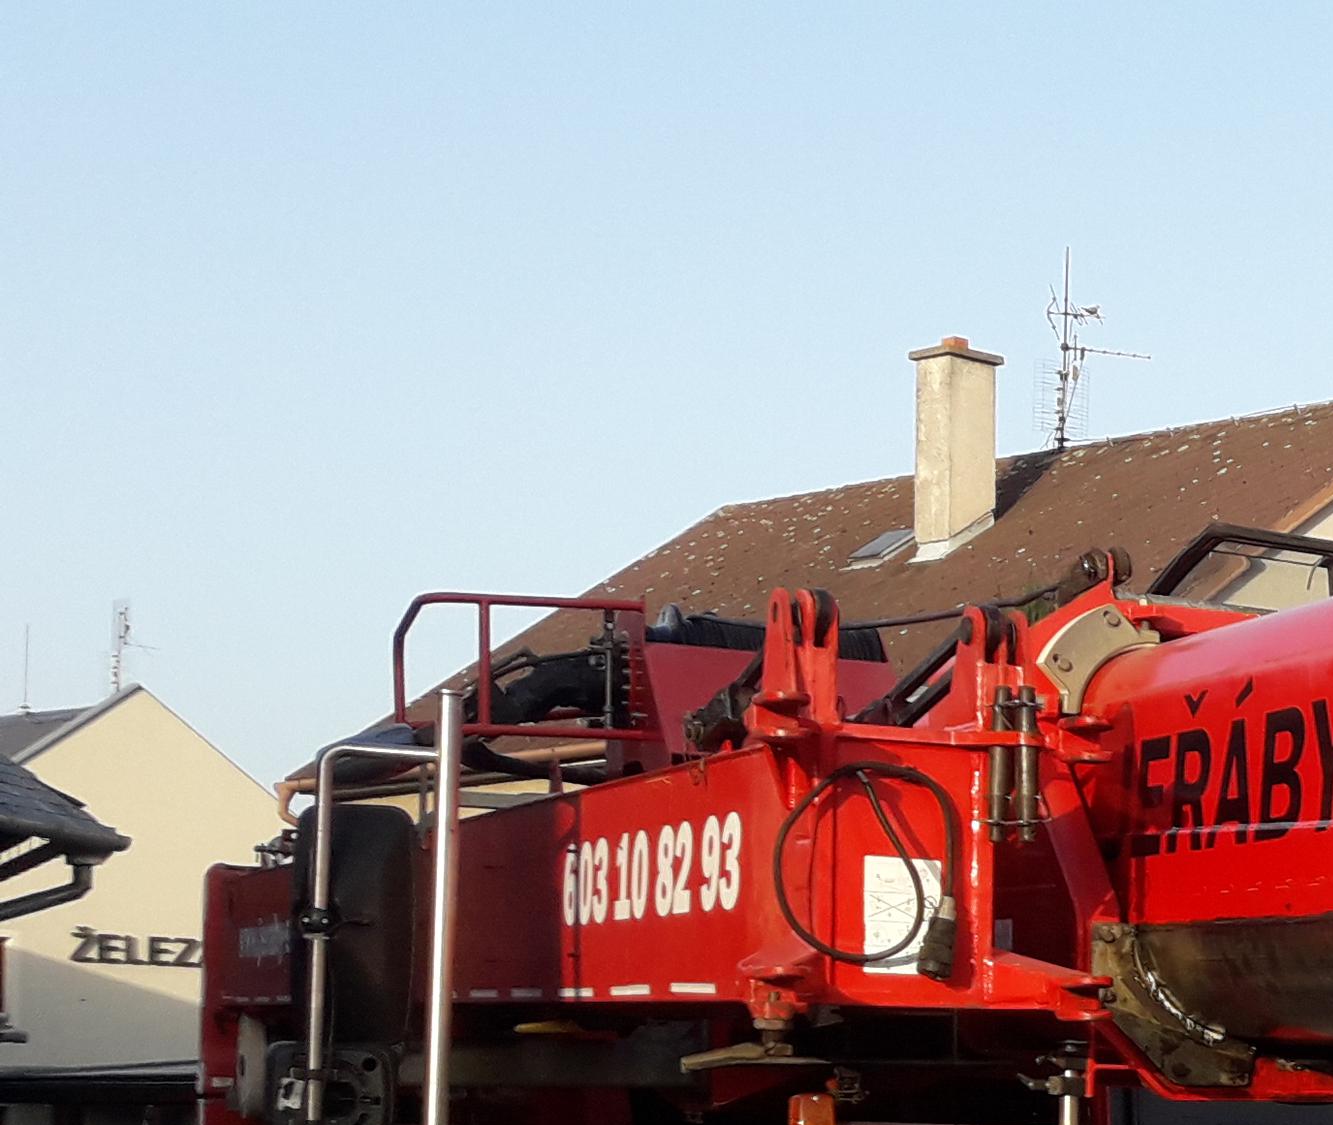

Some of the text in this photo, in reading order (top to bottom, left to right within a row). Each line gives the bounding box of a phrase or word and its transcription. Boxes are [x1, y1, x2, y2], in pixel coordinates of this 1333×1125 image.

[563, 811, 742, 927] 603 10 82 93
